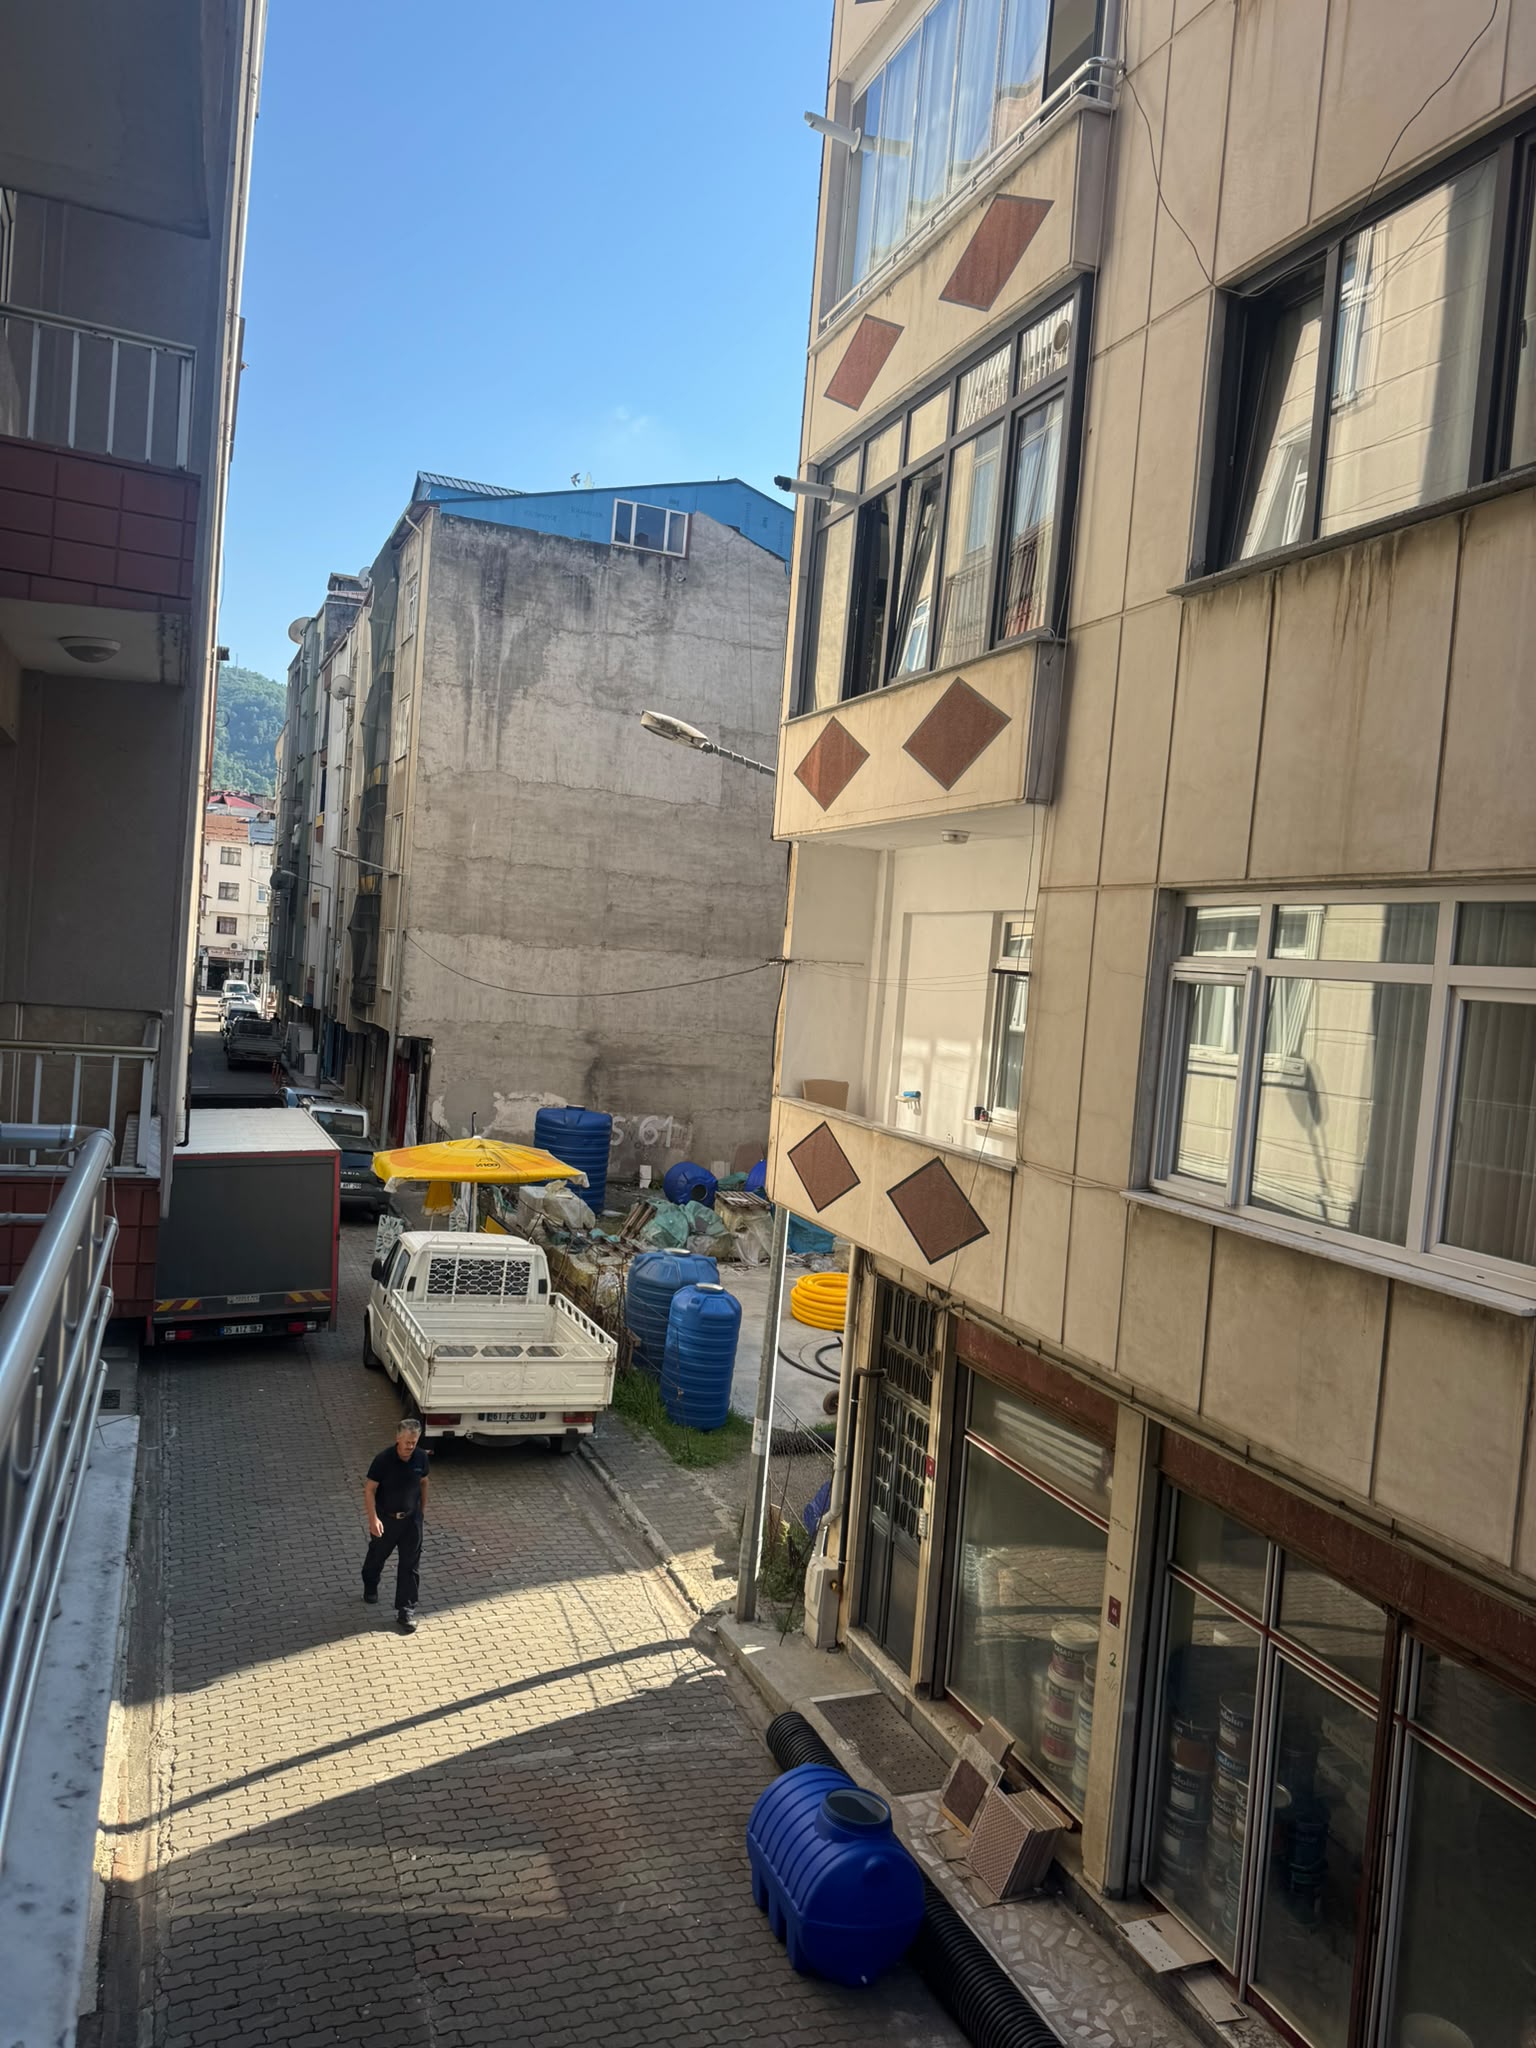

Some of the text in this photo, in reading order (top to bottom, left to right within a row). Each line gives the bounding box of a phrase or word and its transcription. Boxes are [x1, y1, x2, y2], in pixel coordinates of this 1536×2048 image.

[465, 1371, 577, 1391] OTOSAN
[506, 1411, 516, 1420] PE
[1108, 1652, 1117, 1668] 2
